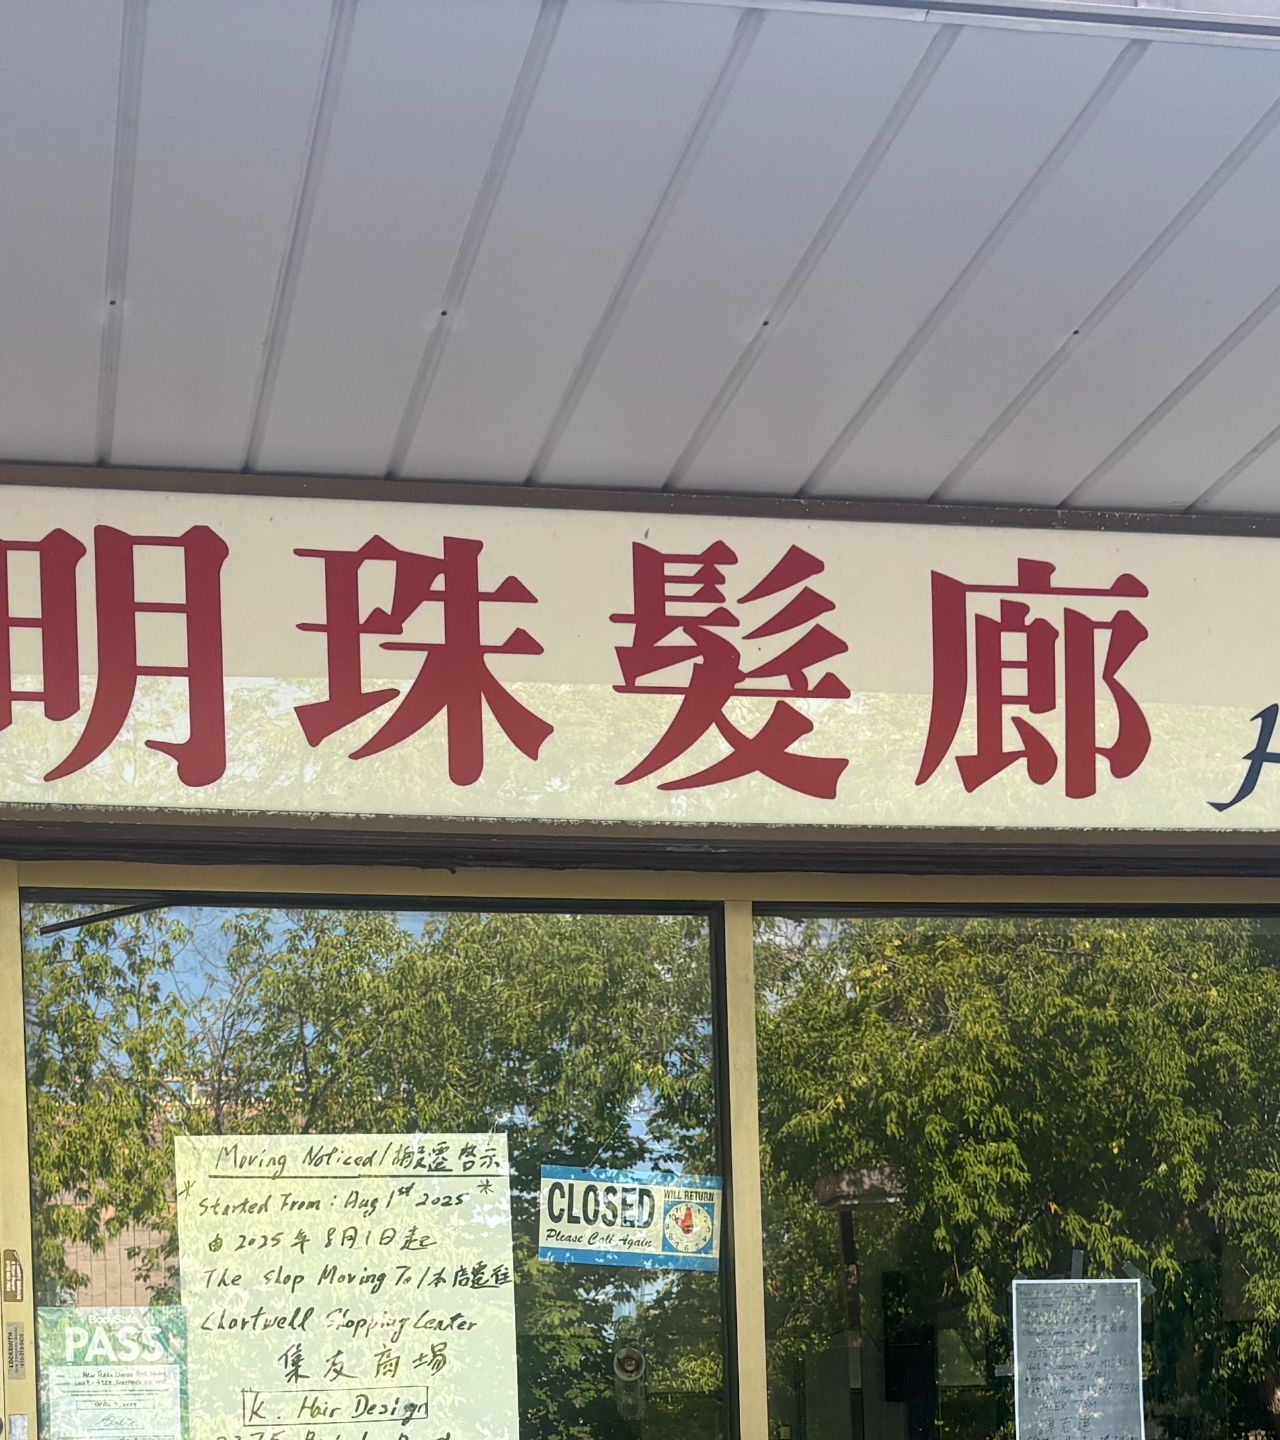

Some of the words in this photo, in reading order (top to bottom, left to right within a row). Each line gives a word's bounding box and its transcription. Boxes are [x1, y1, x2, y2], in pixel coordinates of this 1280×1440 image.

[216, 1143, 288, 1180] Moving
[199, 1193, 270, 1216] Started
[344, 1190, 379, 1218] Aug
[415, 1192, 470, 1208] 2025
[547, 1181, 656, 1229] CLOSED
[664, 1189, 682, 1200] WILL
[684, 1190, 715, 1202] RETURN
[545, 1227, 583, 1244] Please
[618, 1233, 653, 1250] Again
[203, 1268, 243, 1288] The
[317, 1264, 387, 1294] Moving
[65, 1325, 165, 1363] PASS
[297, 1394, 343, 1420] Hair
[350, 1392, 429, 1427] Design
